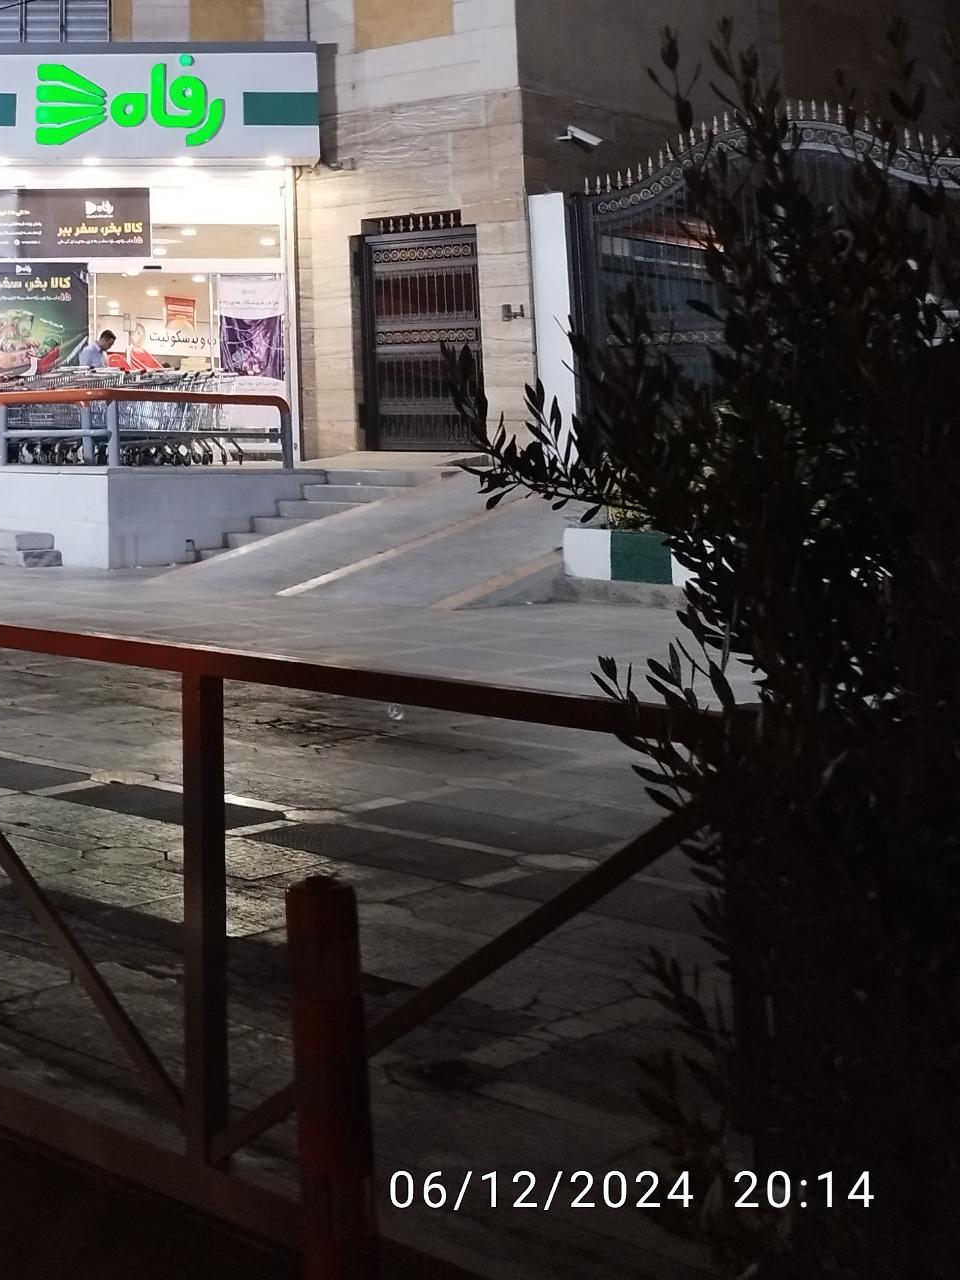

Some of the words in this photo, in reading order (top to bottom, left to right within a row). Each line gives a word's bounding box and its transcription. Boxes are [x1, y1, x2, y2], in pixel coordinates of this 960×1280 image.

[110, 53, 226, 147] رفاه
[74, 222, 98, 237] سفر
[124, 222, 143, 233] کالا
[50, 276, 71, 289] کالا
